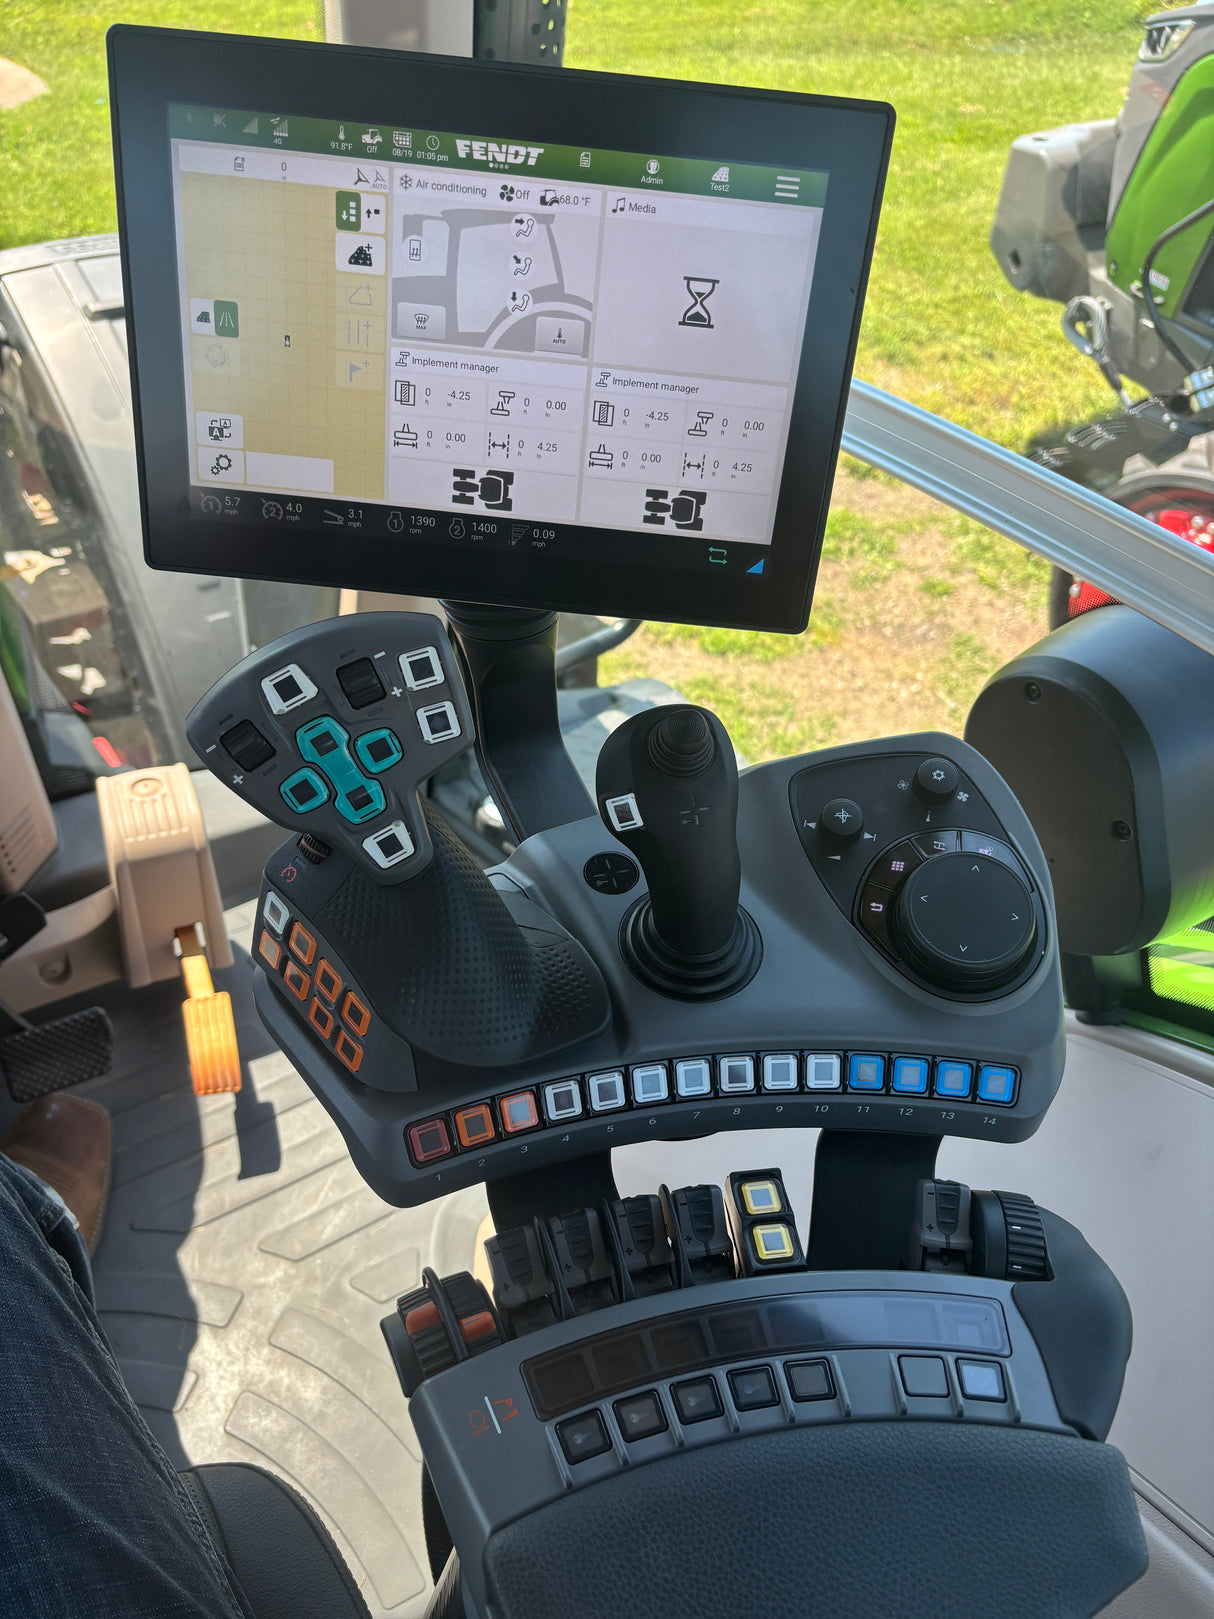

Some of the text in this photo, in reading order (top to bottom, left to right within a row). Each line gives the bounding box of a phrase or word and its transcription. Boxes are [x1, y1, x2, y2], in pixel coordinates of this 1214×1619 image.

[330, 141, 353, 152] 91.8°F
[366, 144, 378, 154] Off
[455, 138, 544, 166] FENDT
[392, 147, 413, 158] 08/19
[416, 150, 449, 162] 01:05 pm
[280, 161, 288, 172] 0
[640, 175, 664, 186] Admin
[416, 178, 488, 198] Air conditioning
[710, 183, 730, 192] Test2
[516, 190, 530, 200] Off
[559, 194, 591, 207] 68.0 °F
[628, 202, 657, 214] Media
[412, 356, 499, 374] Implement manager
[612, 376, 700, 394] Implement manager
[425, 388, 471, 401] 0 -4.25
[524, 398, 567, 410] 0 0.00
[624, 408, 670, 422] 0 -4.25
[722, 419, 765, 431] 0 0.00
[427, 430, 466, 443] 0 0.00
[518, 440, 558, 452] 0 4.25
[622, 451, 662, 463] 0 0.00
[713, 460, 753, 473] 0 4.25
[224, 496, 240, 507] 5.7
[286, 503, 303, 513] 4.0
[348, 509, 363, 519] 3.1
[410, 515, 436, 527] 1390
[454, 526, 461, 536] 2
[472, 522, 497, 534] 1400
[533, 529, 556, 540] 0.09
[732, 1107, 741, 1116] 8
[775, 1105, 784, 1113] 9
[813, 1104, 829, 1112] 10
[898, 1108, 914, 1116] 12
[648, 1117, 658, 1125] 6
[940, 1111, 956, 1120] 13
[981, 1116, 998, 1126] 14
[606, 1125, 615, 1133] 5
[562, 1134, 571, 1142] 4
